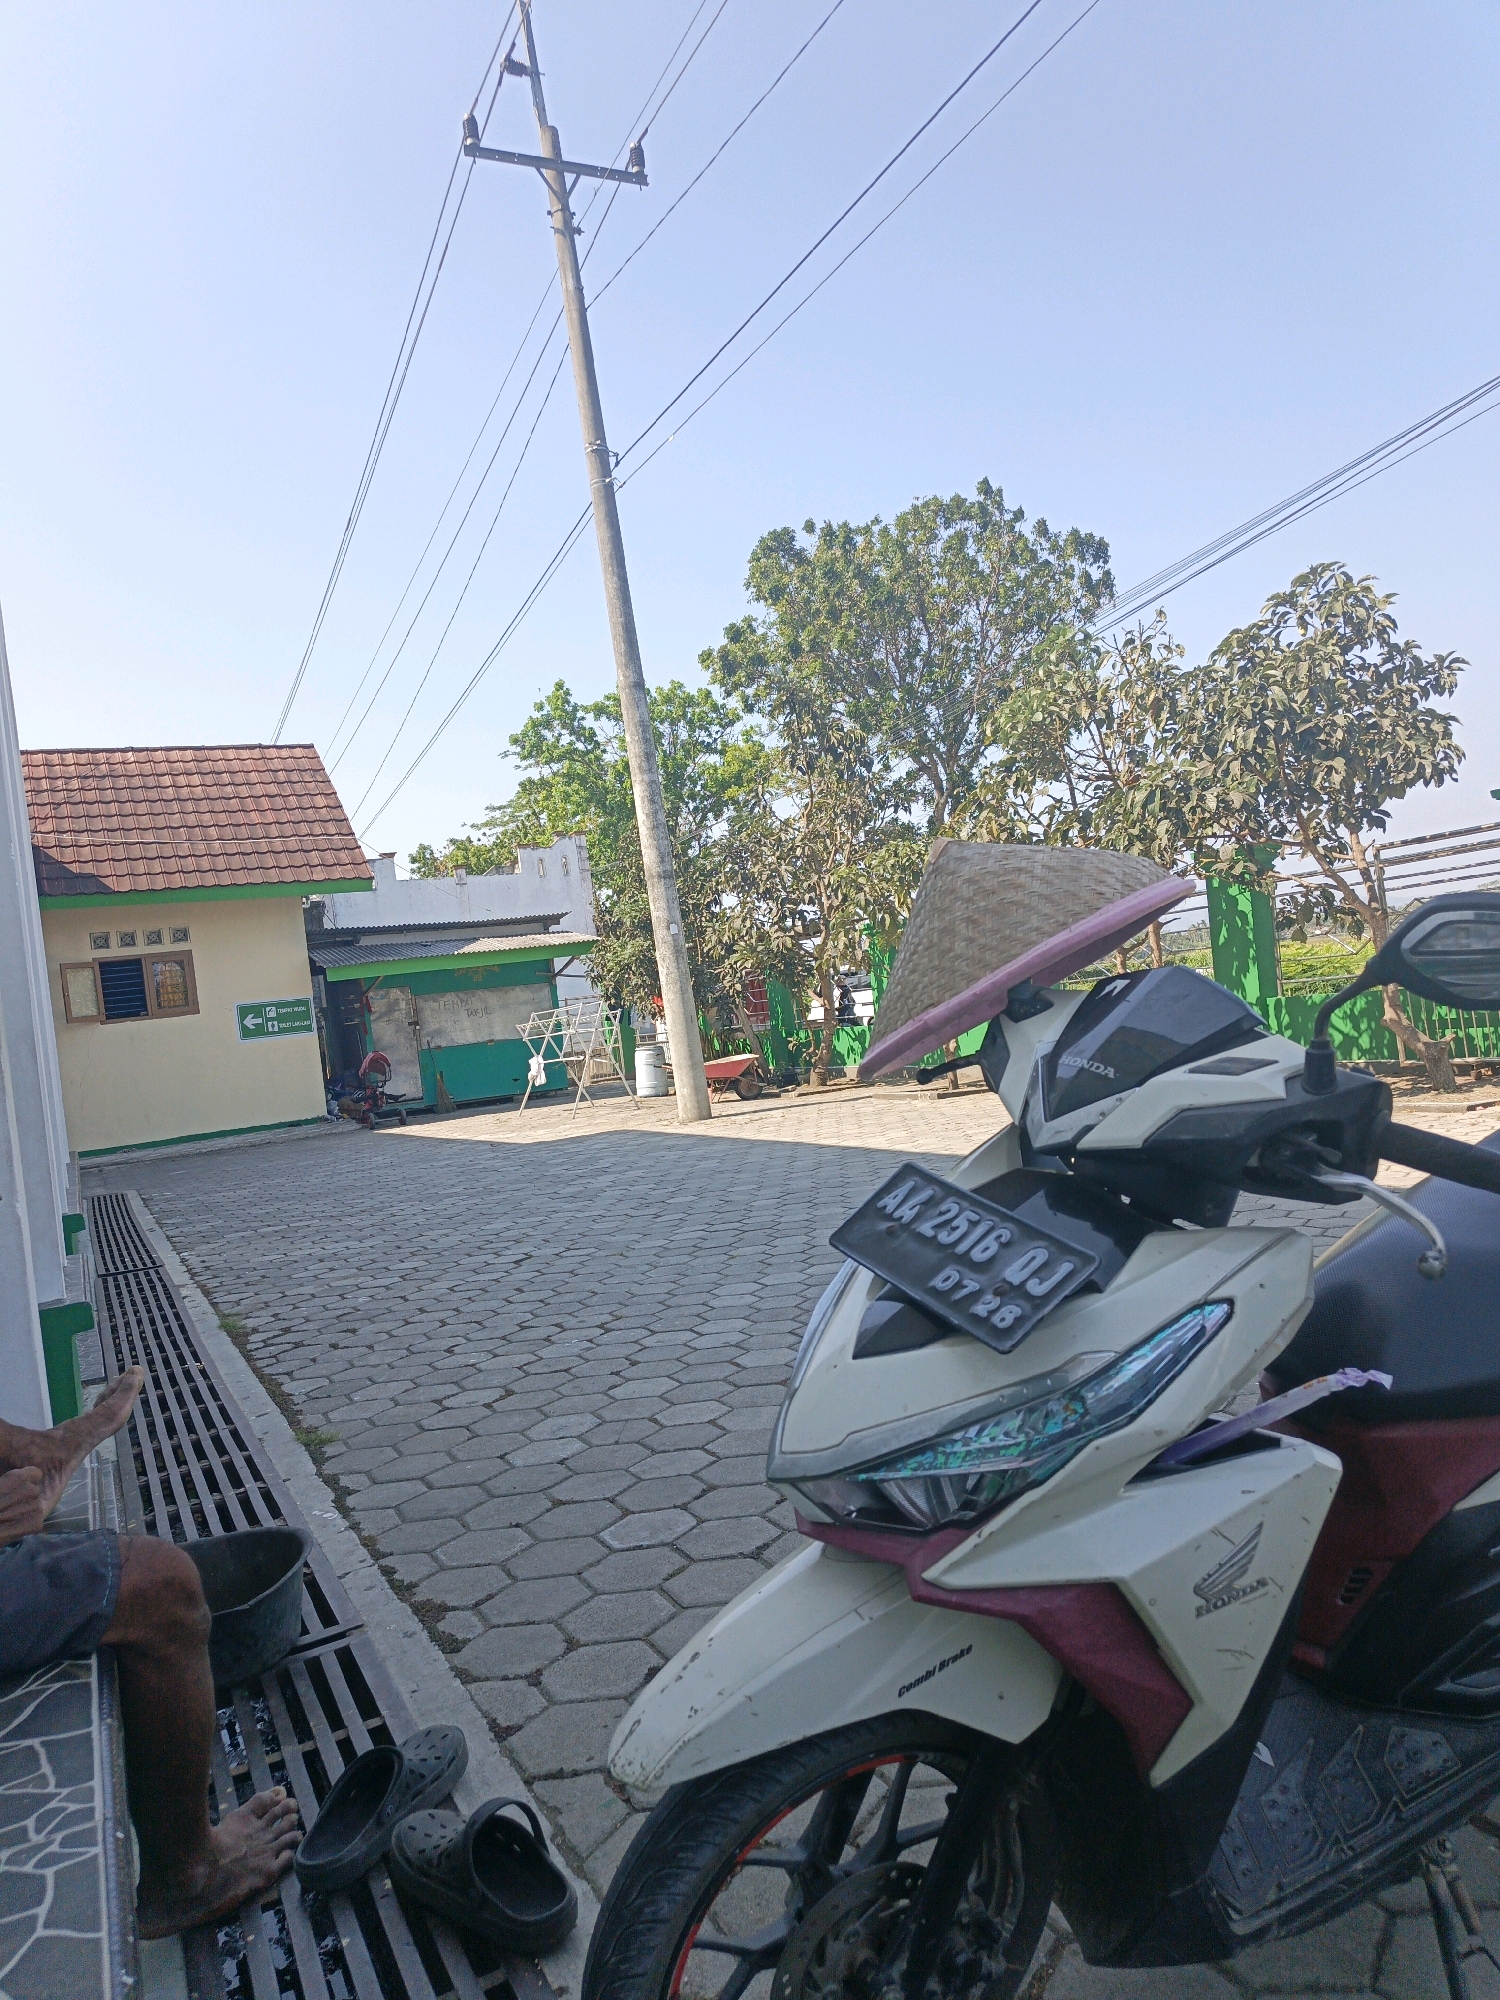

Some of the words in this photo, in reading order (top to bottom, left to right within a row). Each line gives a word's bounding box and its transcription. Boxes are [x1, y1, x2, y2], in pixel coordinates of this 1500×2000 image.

[278, 1021, 292, 1029] TOILET
[464, 1006, 492, 1018] TAKJIL
[1058, 1055, 1115, 1078] HONDA
[876, 1180, 935, 1224] AA
[915, 1202, 1012, 1263] 2516
[1004, 1247, 1075, 1297] QJ
[928, 1269, 981, 1300] 07
[1195, 1577, 1269, 1619] HONDA
[897, 1664, 937, 1698] Combi
[938, 1643, 973, 1673] Brake
